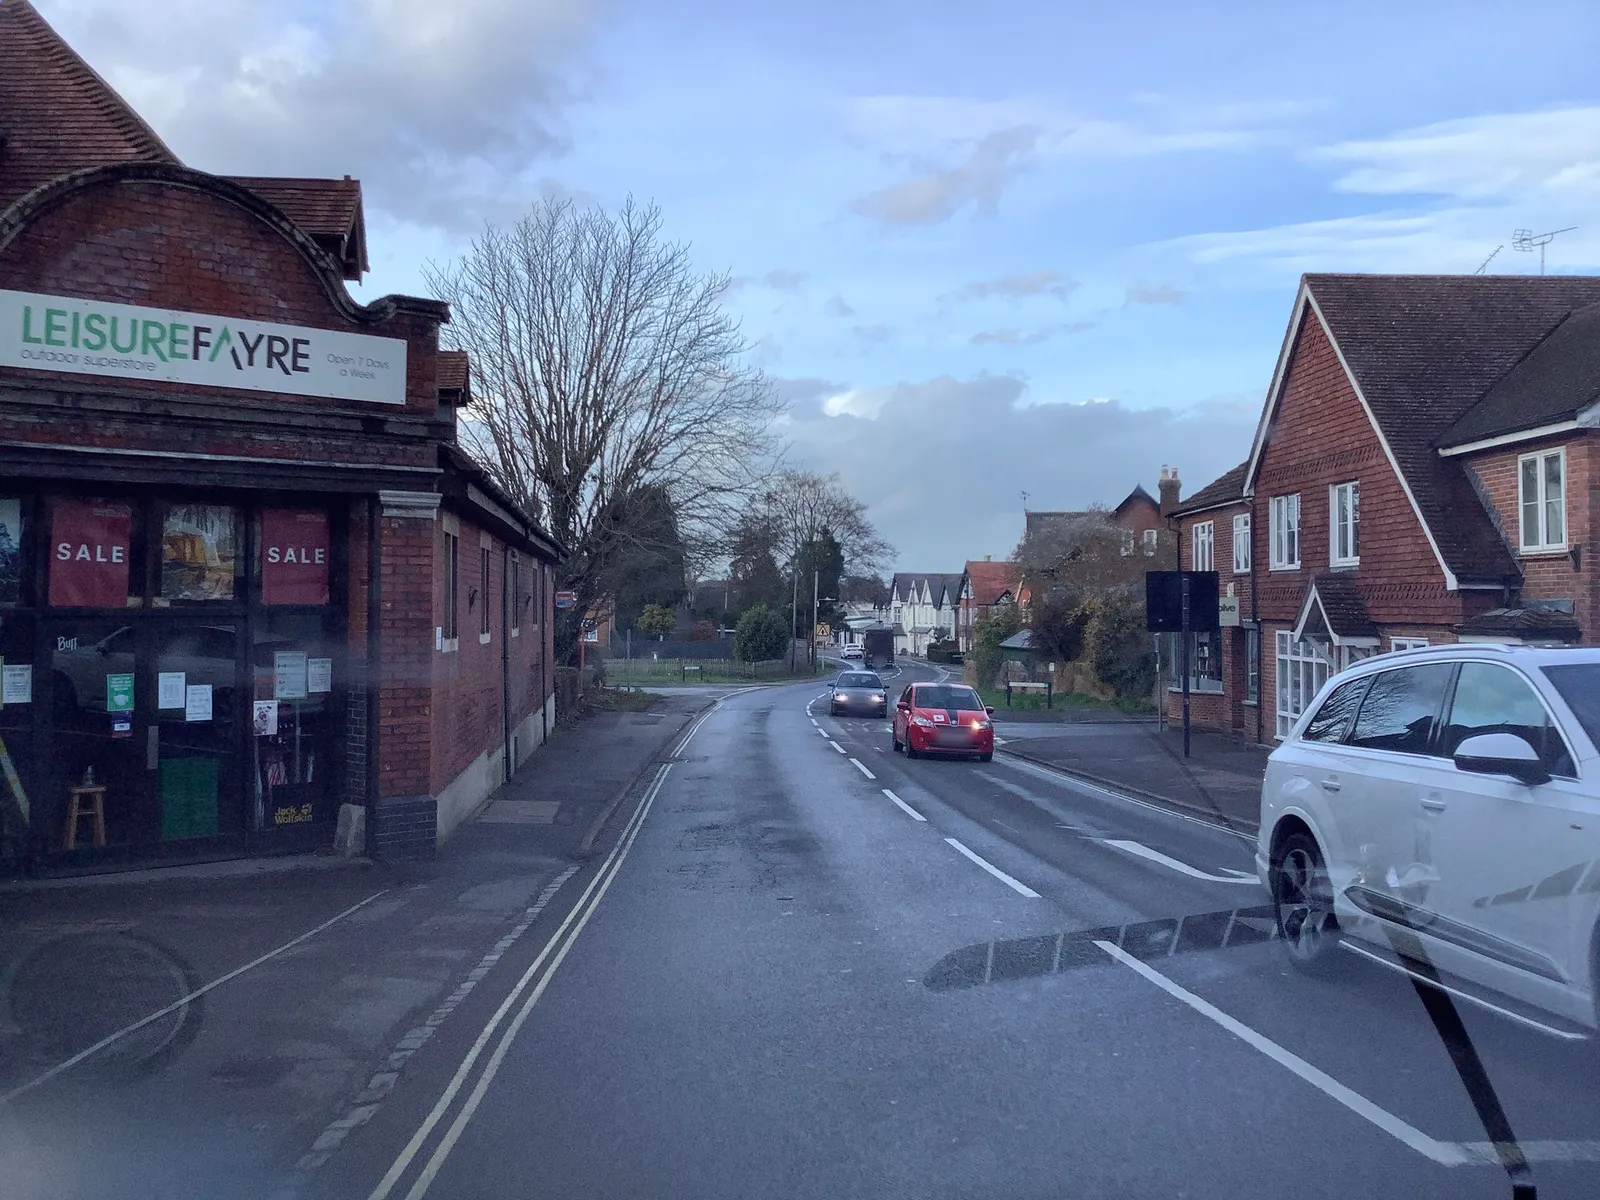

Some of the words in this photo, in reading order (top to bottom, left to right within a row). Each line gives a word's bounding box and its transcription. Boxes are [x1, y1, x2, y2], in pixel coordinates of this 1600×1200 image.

[22, 305, 310, 376] LEISUREFAYRE
[20, 348, 80, 364] outdoor
[84, 354, 157, 373] superstore
[327, 353, 355, 367] Open
[358, 357, 364, 367] 7
[366, 357, 390, 371] Days
[340, 369, 348, 377] a
[348, 369, 377, 380] Week
[56, 542, 125, 564] SALE
[267, 546, 325, 566] SALE
[274, 805, 296, 815] Jack
[274, 813, 313, 824] Wolfskin
